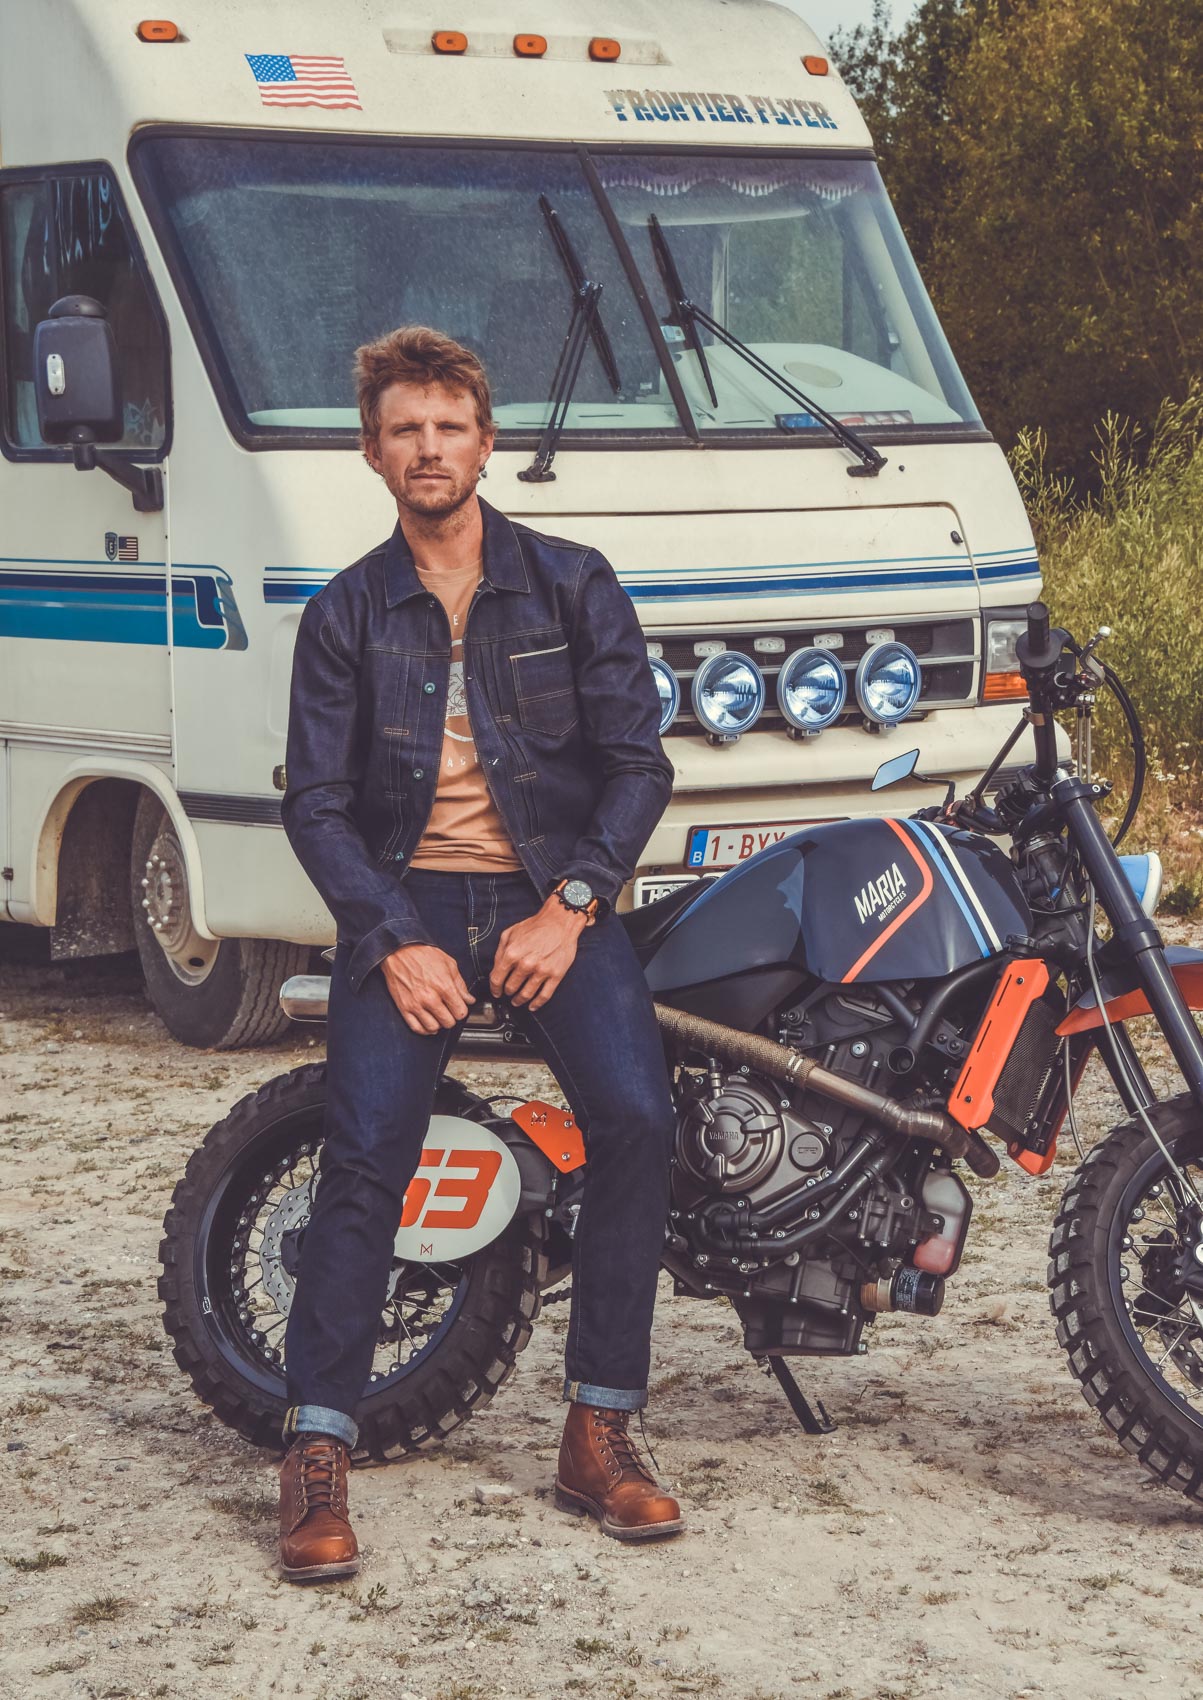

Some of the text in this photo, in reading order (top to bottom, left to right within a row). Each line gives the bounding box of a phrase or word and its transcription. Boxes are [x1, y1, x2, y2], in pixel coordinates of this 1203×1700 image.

[602, 89, 838, 130] FRONTIER FLYER
[692, 852, 703, 863] B
[854, 862, 907, 925] MARIA
[878, 890, 907, 922] MOTORCYCLES
[709, 1131, 739, 1141] YAMAHA
